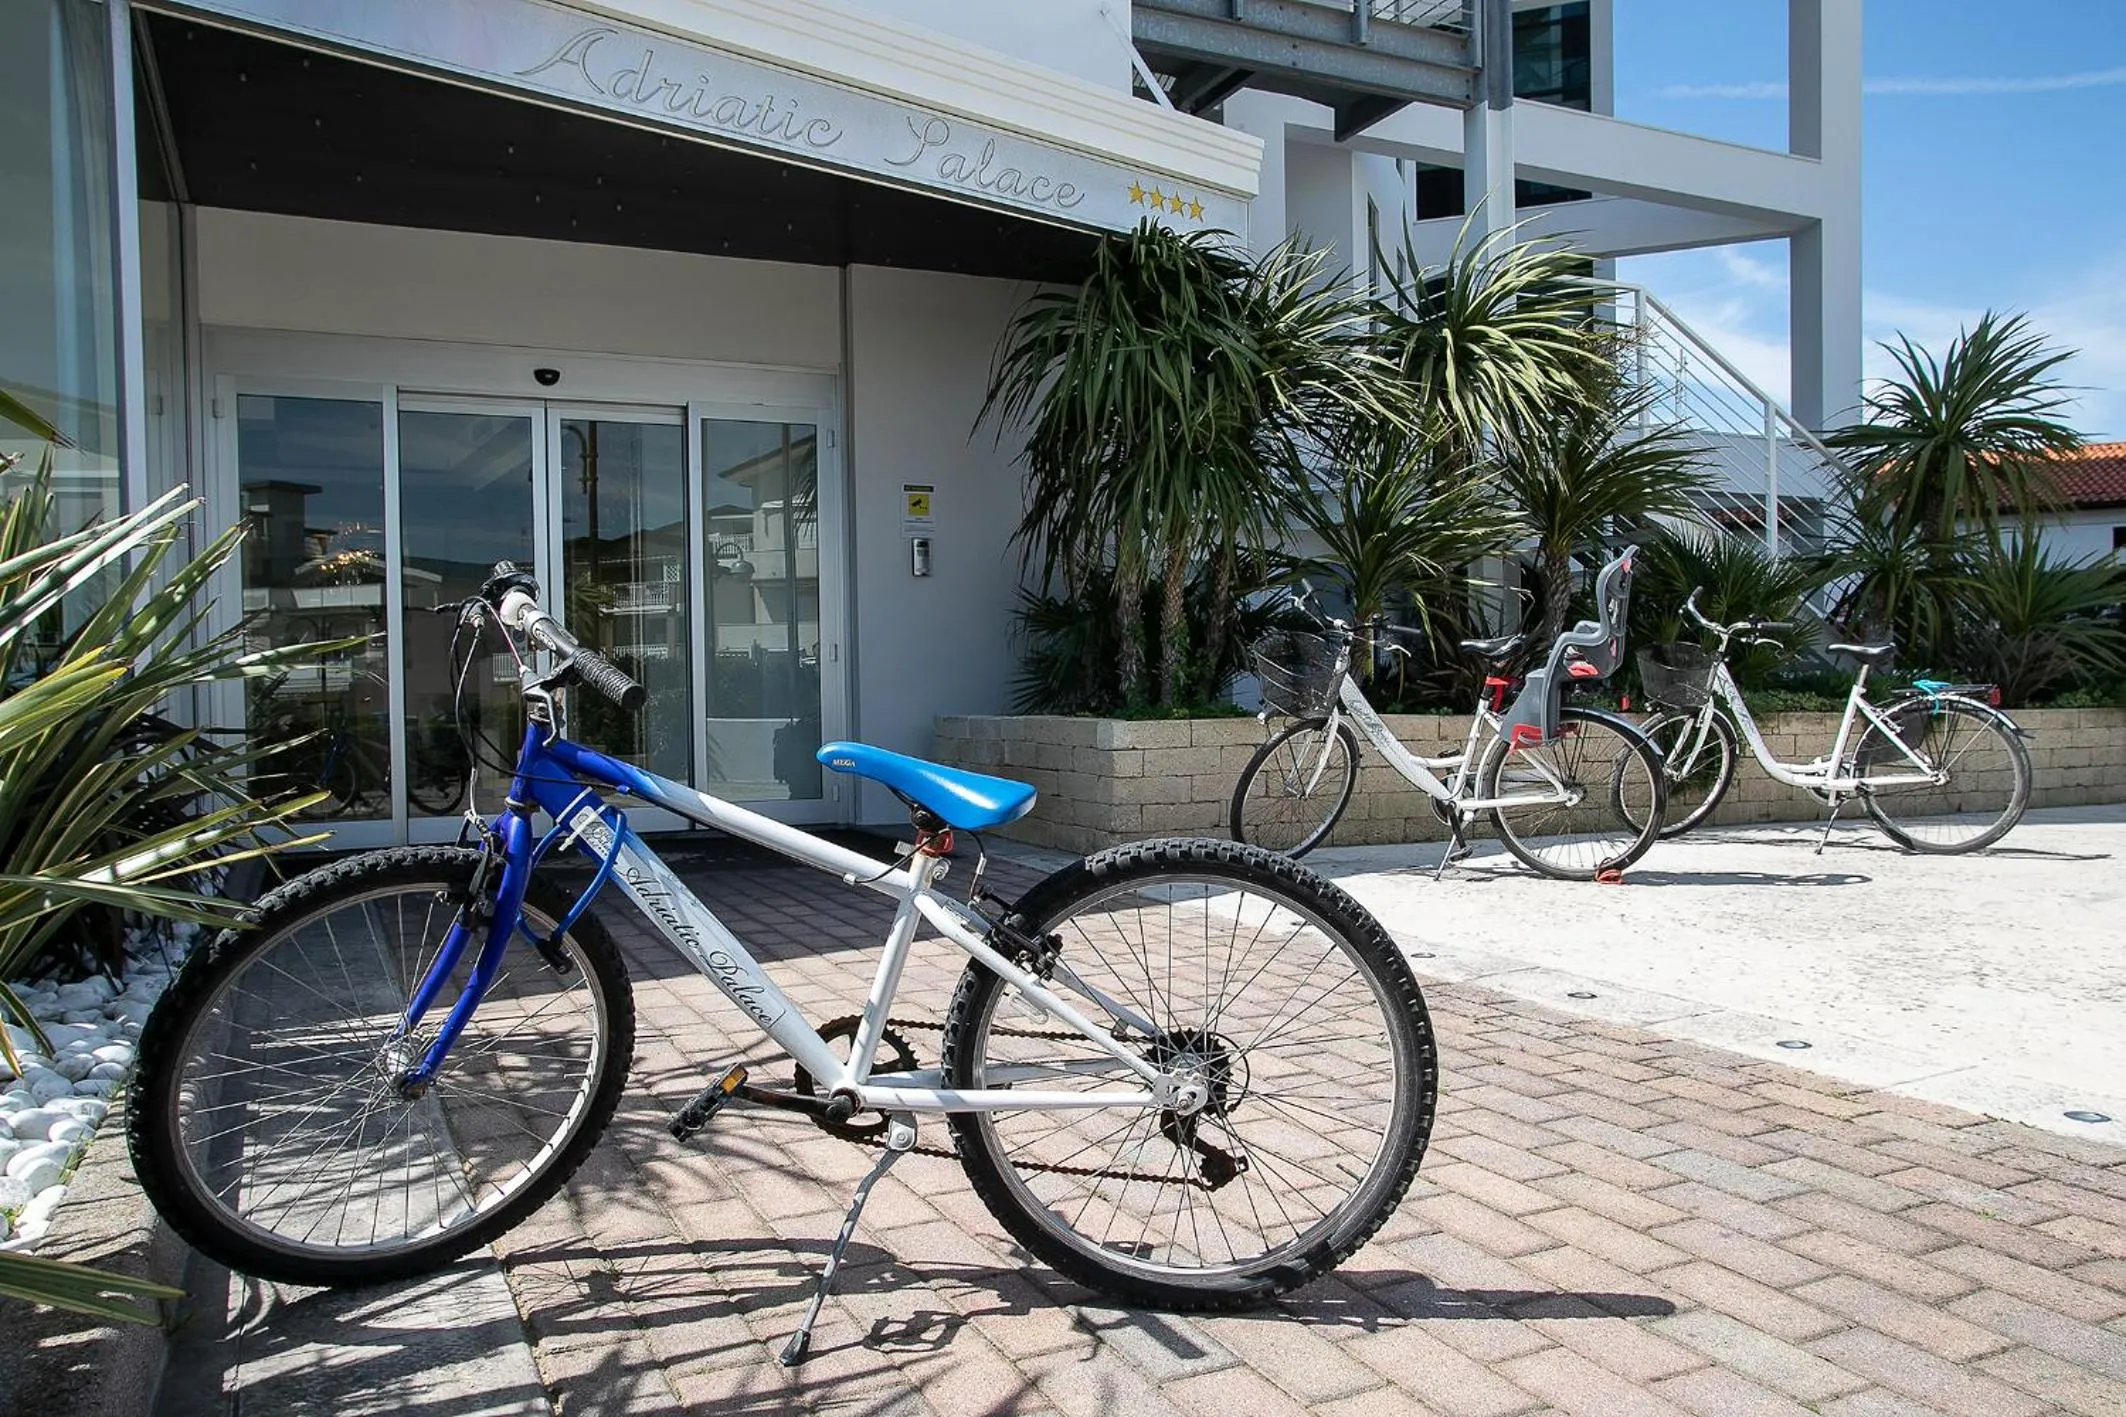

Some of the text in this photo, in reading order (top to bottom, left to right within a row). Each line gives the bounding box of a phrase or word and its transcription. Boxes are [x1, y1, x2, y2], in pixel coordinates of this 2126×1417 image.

[514, 28, 1085, 208] Adriatic Palace
[616, 864, 772, 1024] Adriatic Palace
